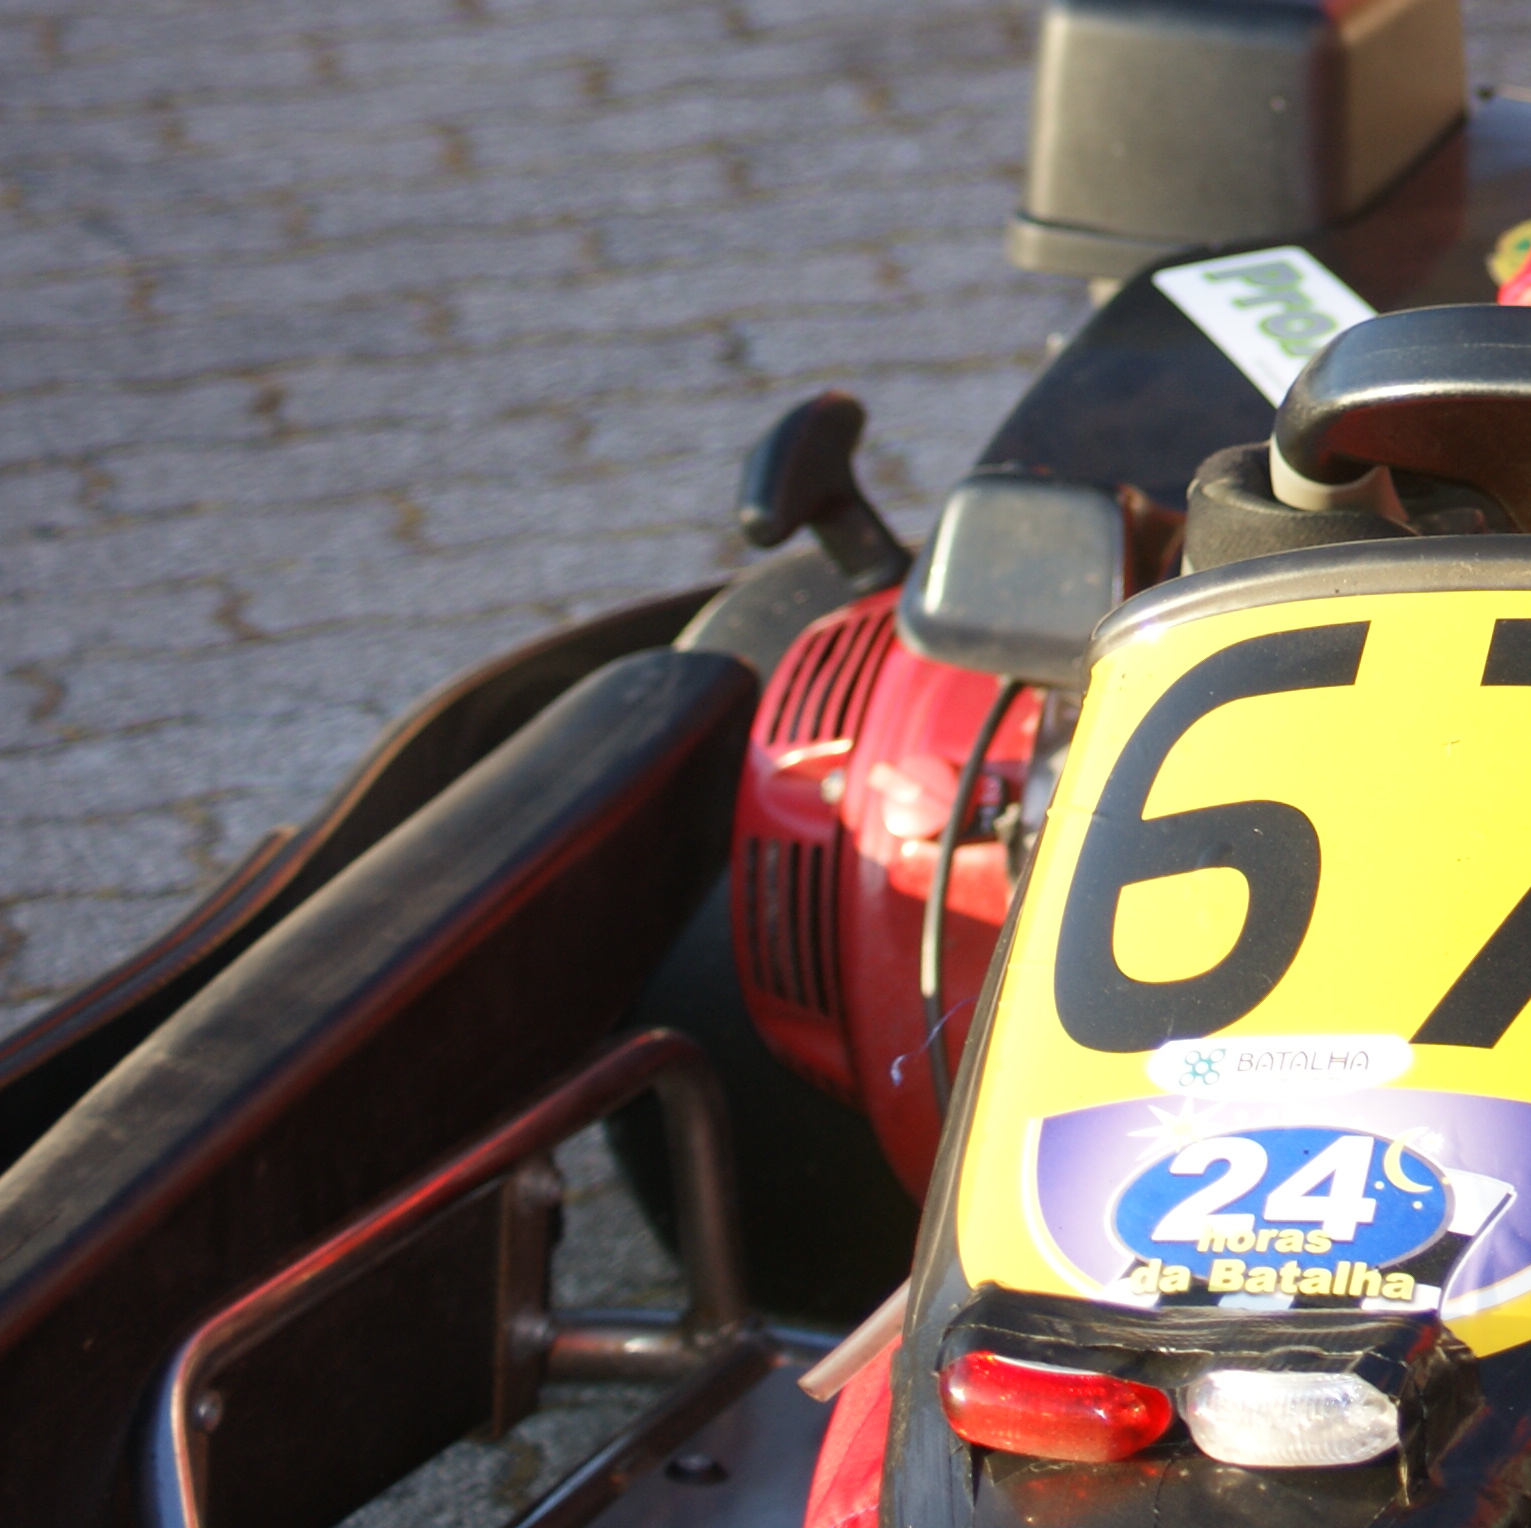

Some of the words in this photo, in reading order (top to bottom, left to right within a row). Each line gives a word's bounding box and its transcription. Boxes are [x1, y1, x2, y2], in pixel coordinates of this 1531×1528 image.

[1237, 1050, 1369, 1072] BATALHA
[1151, 1135, 1377, 1242] 24
[1196, 1225, 1333, 1254] horas
[1128, 1258, 1192, 1294] da
[1207, 1258, 1416, 1301] Batalha
